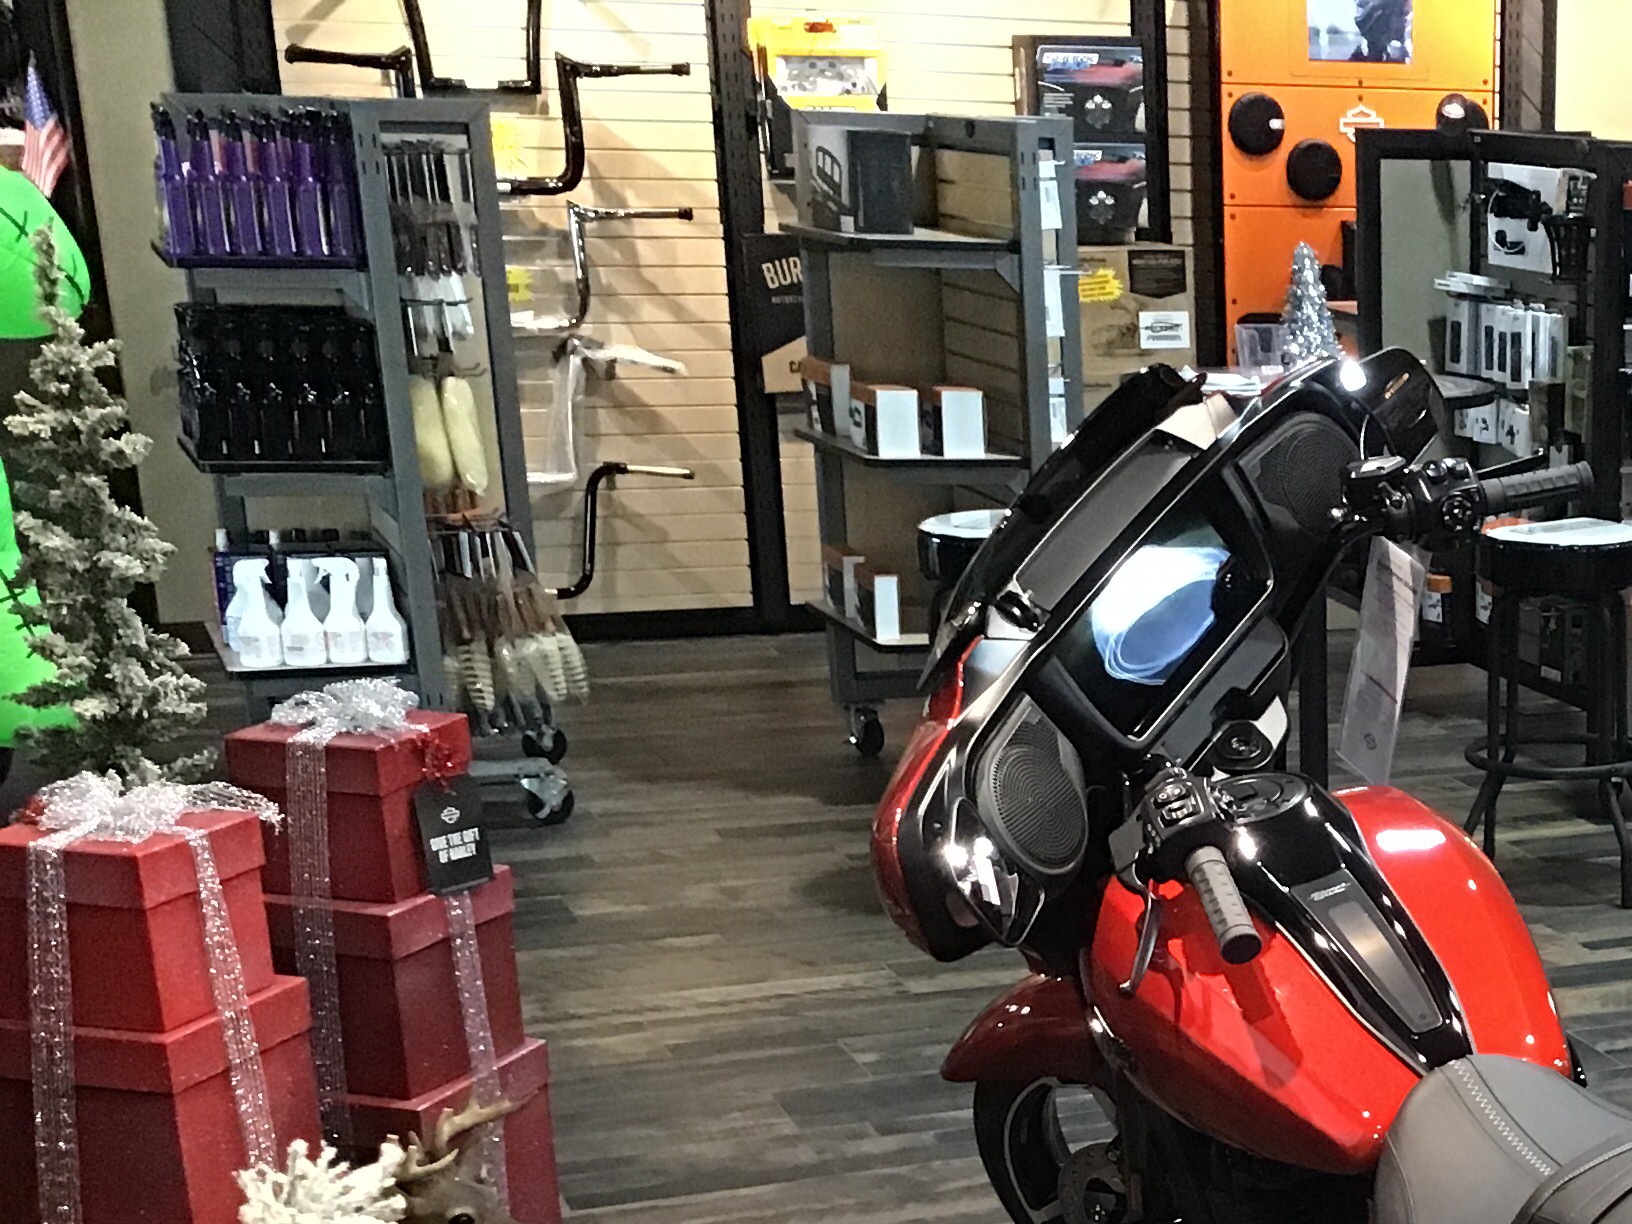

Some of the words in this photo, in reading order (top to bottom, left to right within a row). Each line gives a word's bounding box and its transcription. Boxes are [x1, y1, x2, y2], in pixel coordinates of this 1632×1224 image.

[447, 832, 463, 847] THE
[463, 827, 480, 843] GIFT
[438, 849, 449, 864] OF
